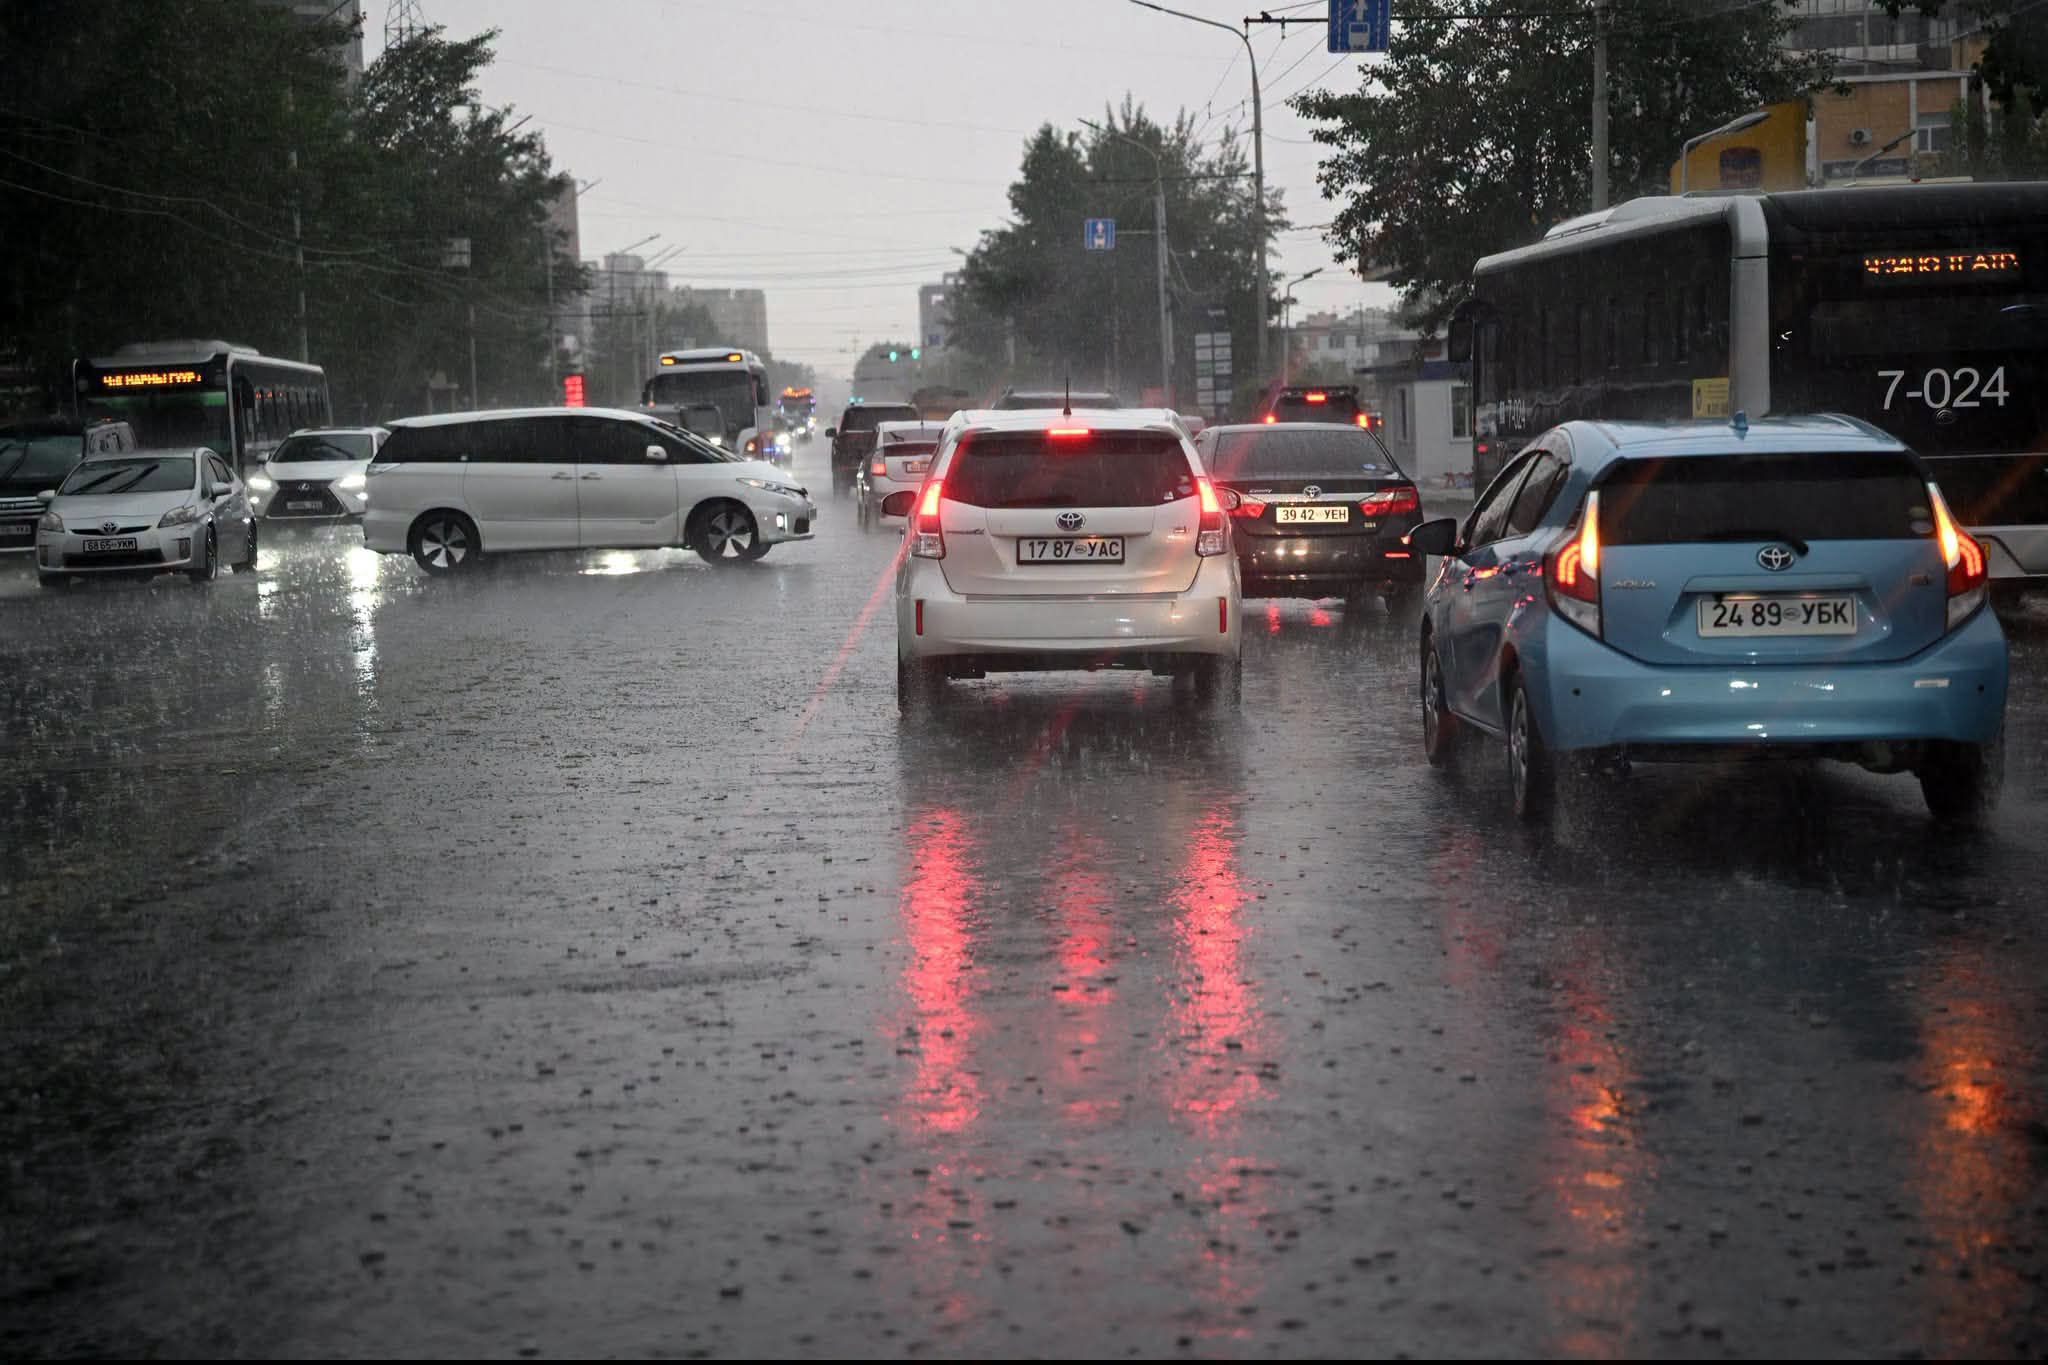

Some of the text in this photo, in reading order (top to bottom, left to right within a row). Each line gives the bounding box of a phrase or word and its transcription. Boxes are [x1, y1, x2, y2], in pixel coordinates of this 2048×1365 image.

[1877, 366, 2010, 410] 7-024
[1323, 508, 1347, 520] УЕН
[1087, 541, 1120, 557] УАС
[1801, 601, 1849, 625] УБК
